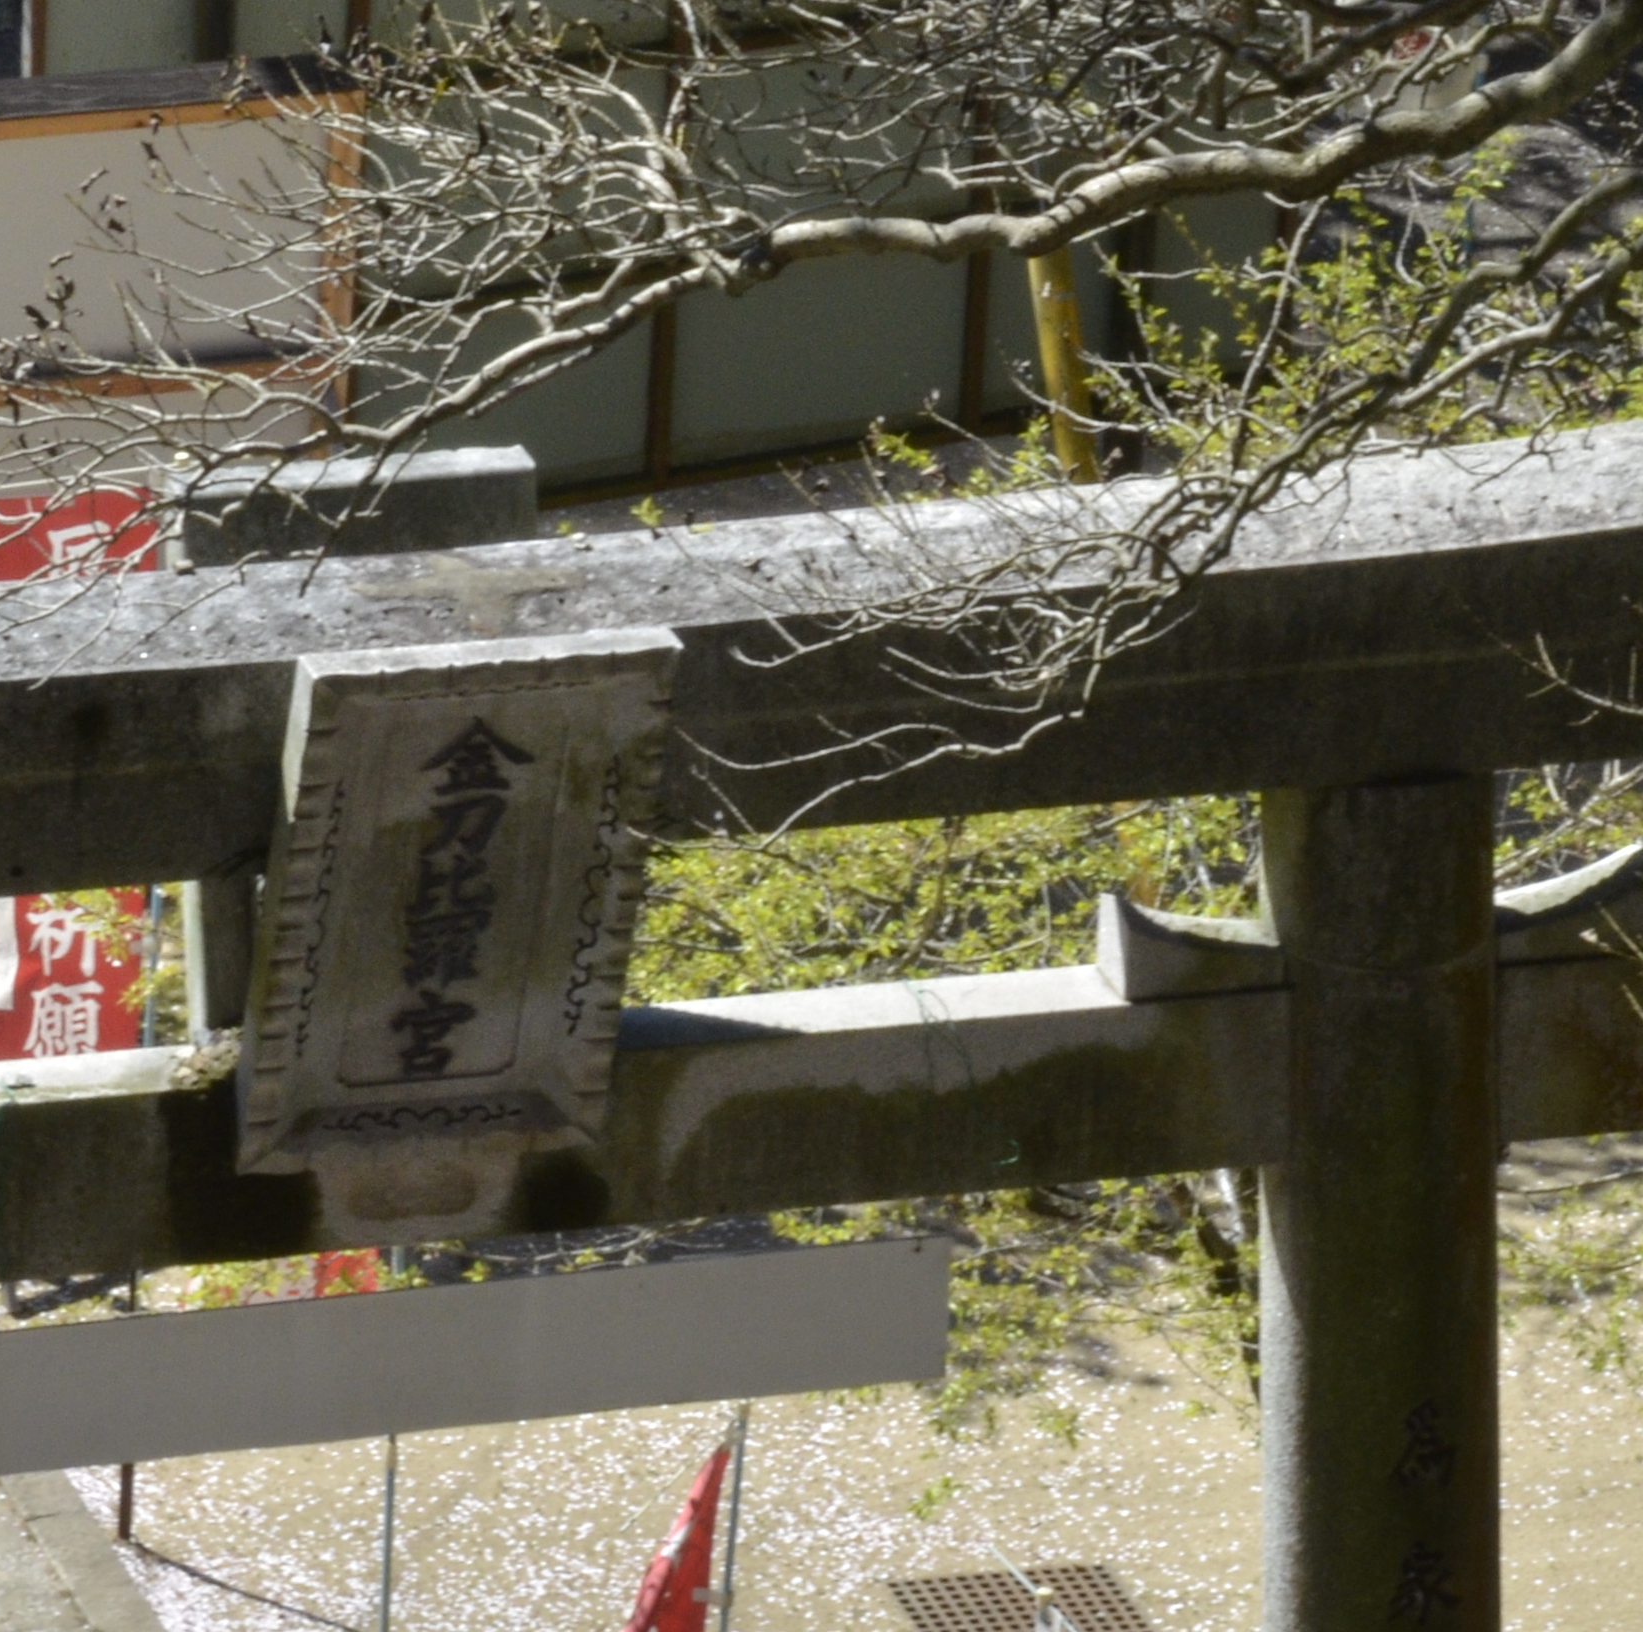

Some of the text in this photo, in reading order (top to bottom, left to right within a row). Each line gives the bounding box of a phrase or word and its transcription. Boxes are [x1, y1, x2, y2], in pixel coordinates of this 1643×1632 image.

[22, 893, 108, 1058] 祈願
[390, 715, 535, 1081] 金刀比羅宮
